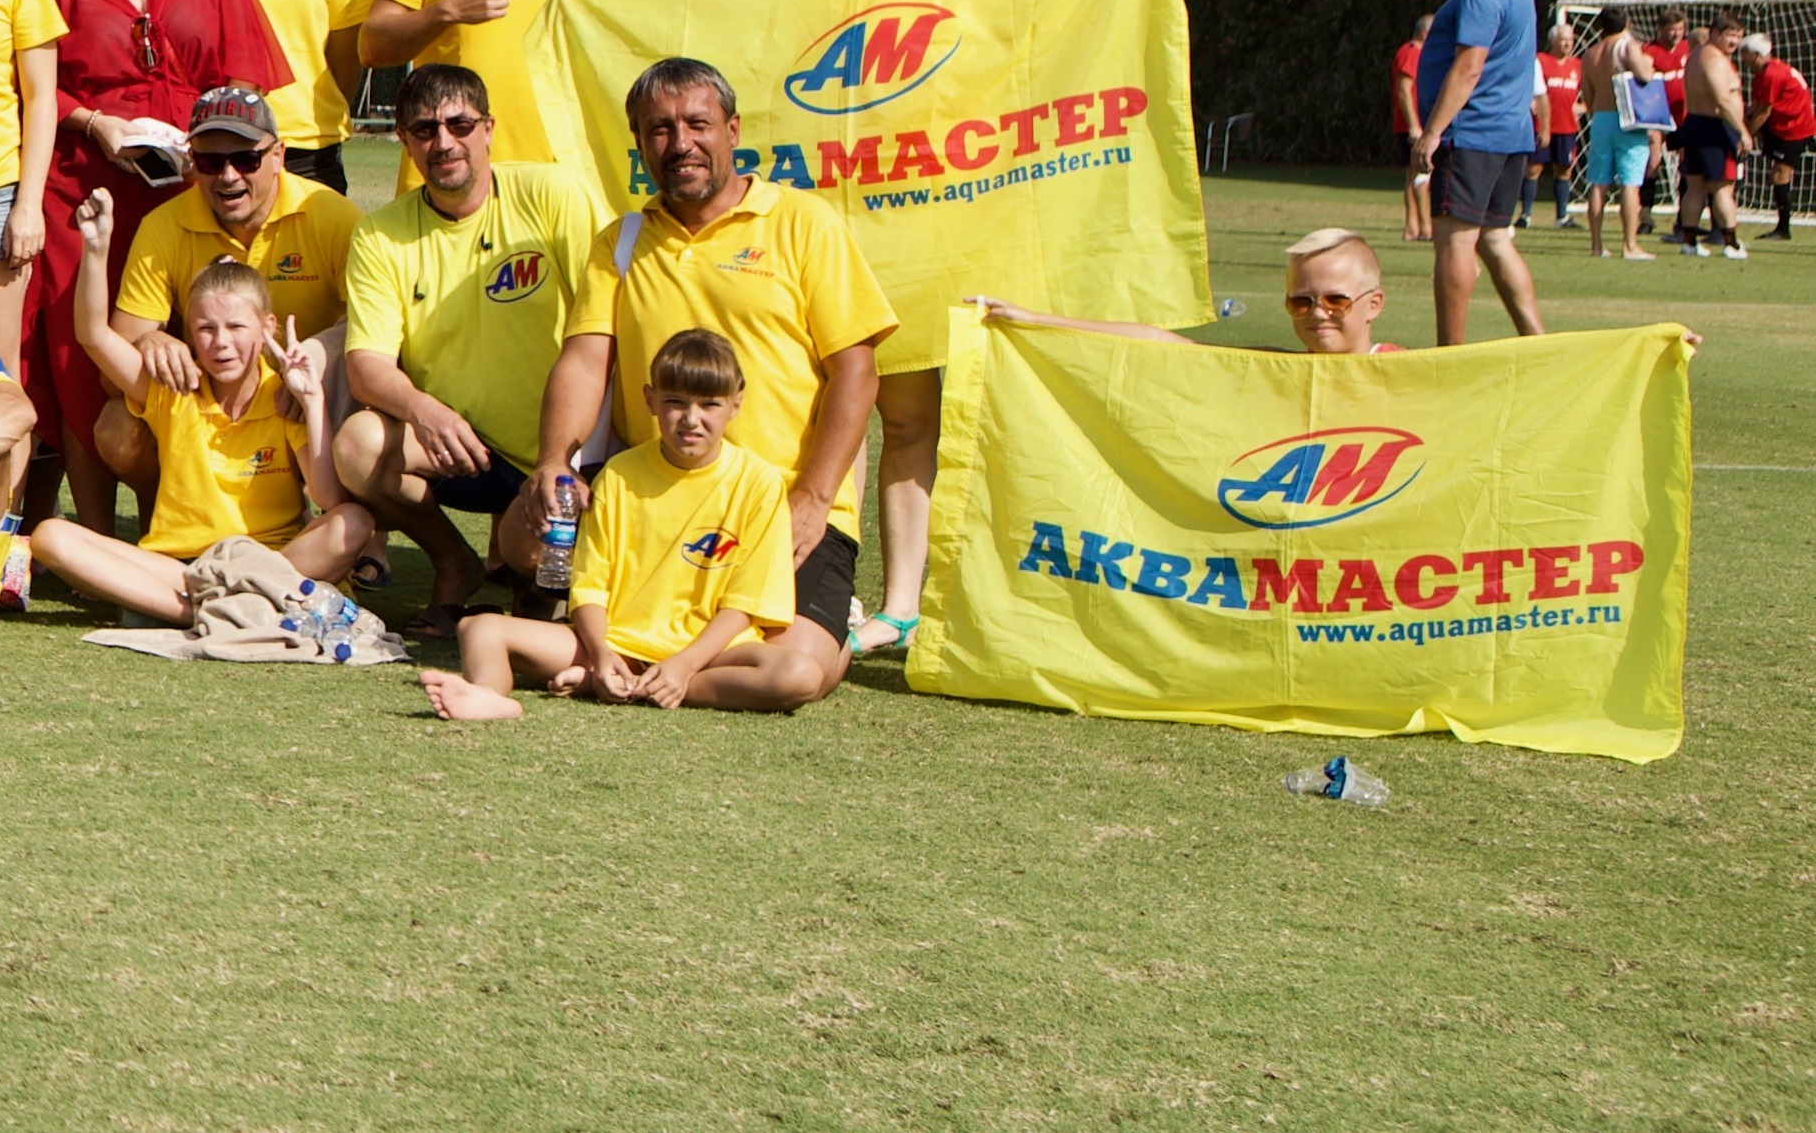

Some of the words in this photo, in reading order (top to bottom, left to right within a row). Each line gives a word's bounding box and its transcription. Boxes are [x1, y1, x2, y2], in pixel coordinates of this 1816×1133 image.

[629, 85, 1148, 196] АВАМАСТЕР
[863, 145, 1132, 212] www.aquamaster.ru
[486, 254, 545, 295] AM
[1019, 521, 1645, 614] АКВАМАСТЕР
[1296, 606, 1621, 646] www.aquamaster.ru
